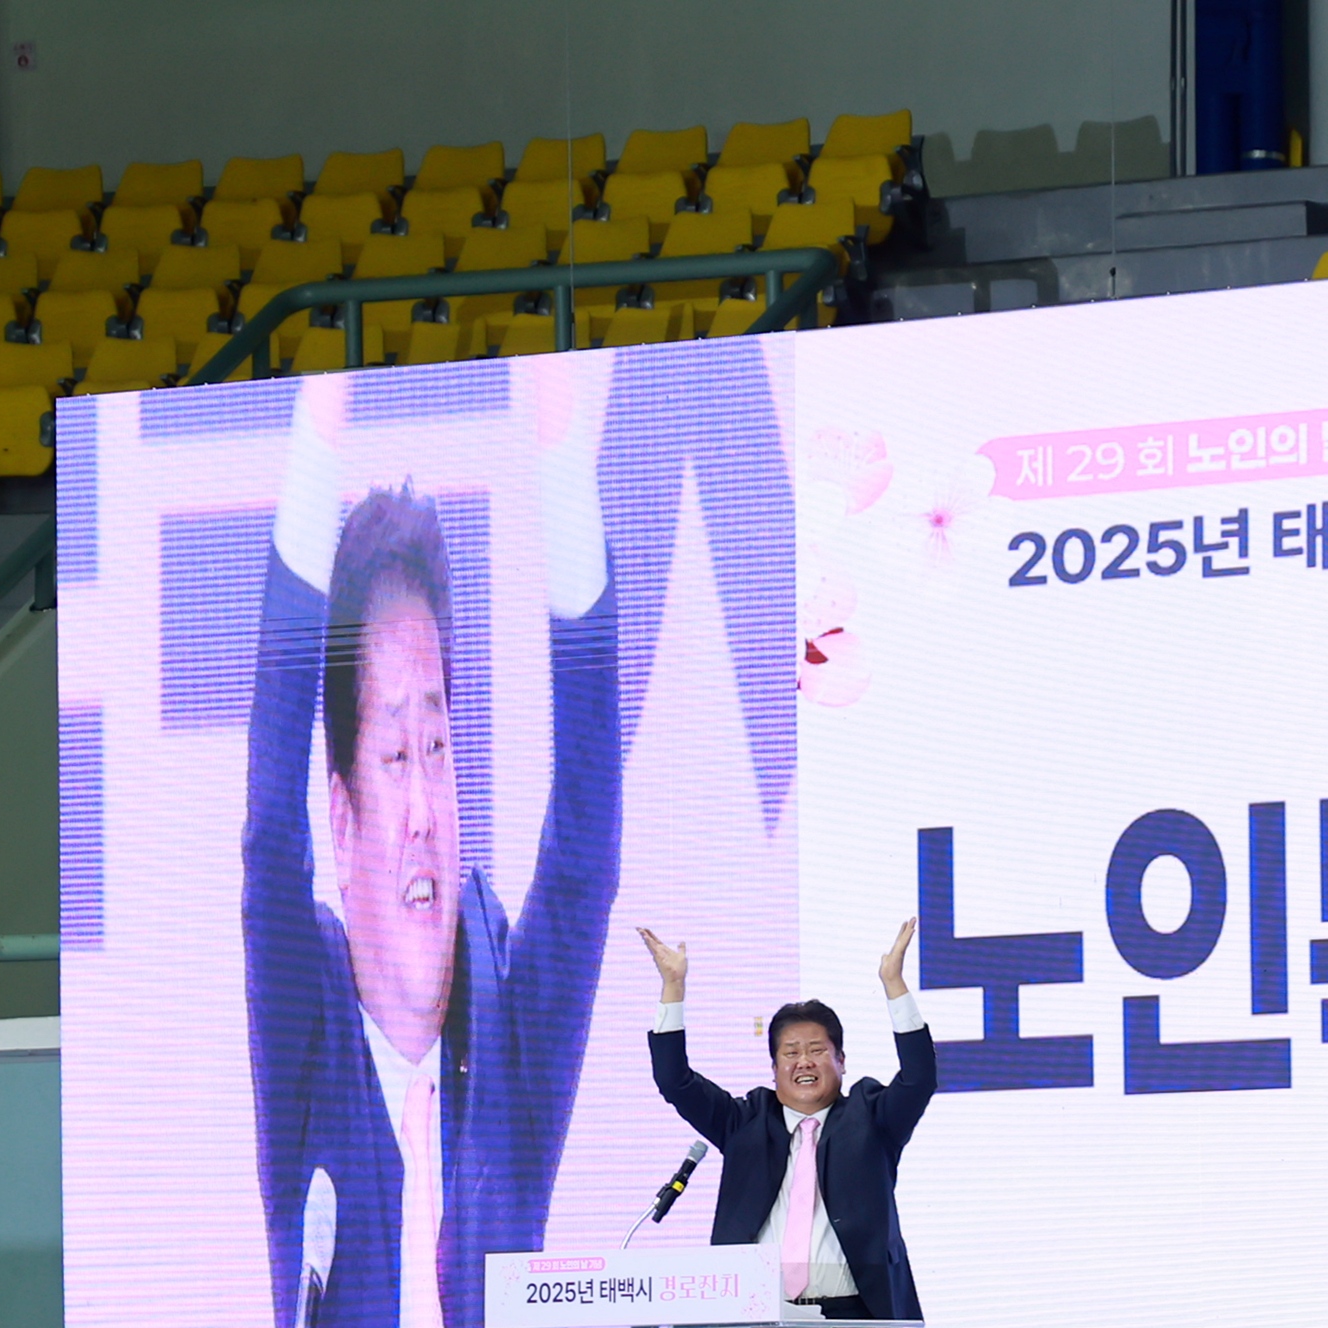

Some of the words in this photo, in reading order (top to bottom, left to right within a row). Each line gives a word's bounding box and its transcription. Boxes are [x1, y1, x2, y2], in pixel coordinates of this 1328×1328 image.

[1015, 445, 1054, 487] 제
[1066, 441, 1126, 483] 29
[1135, 434, 1174, 476] 회
[1185, 422, 1309, 473] 노인의
[1007, 507, 1250, 588] 2025년
[526, 1278, 594, 1304] 2025년
[599, 1276, 653, 1303] 태백시
[658, 1273, 740, 1301] 경로잔치
